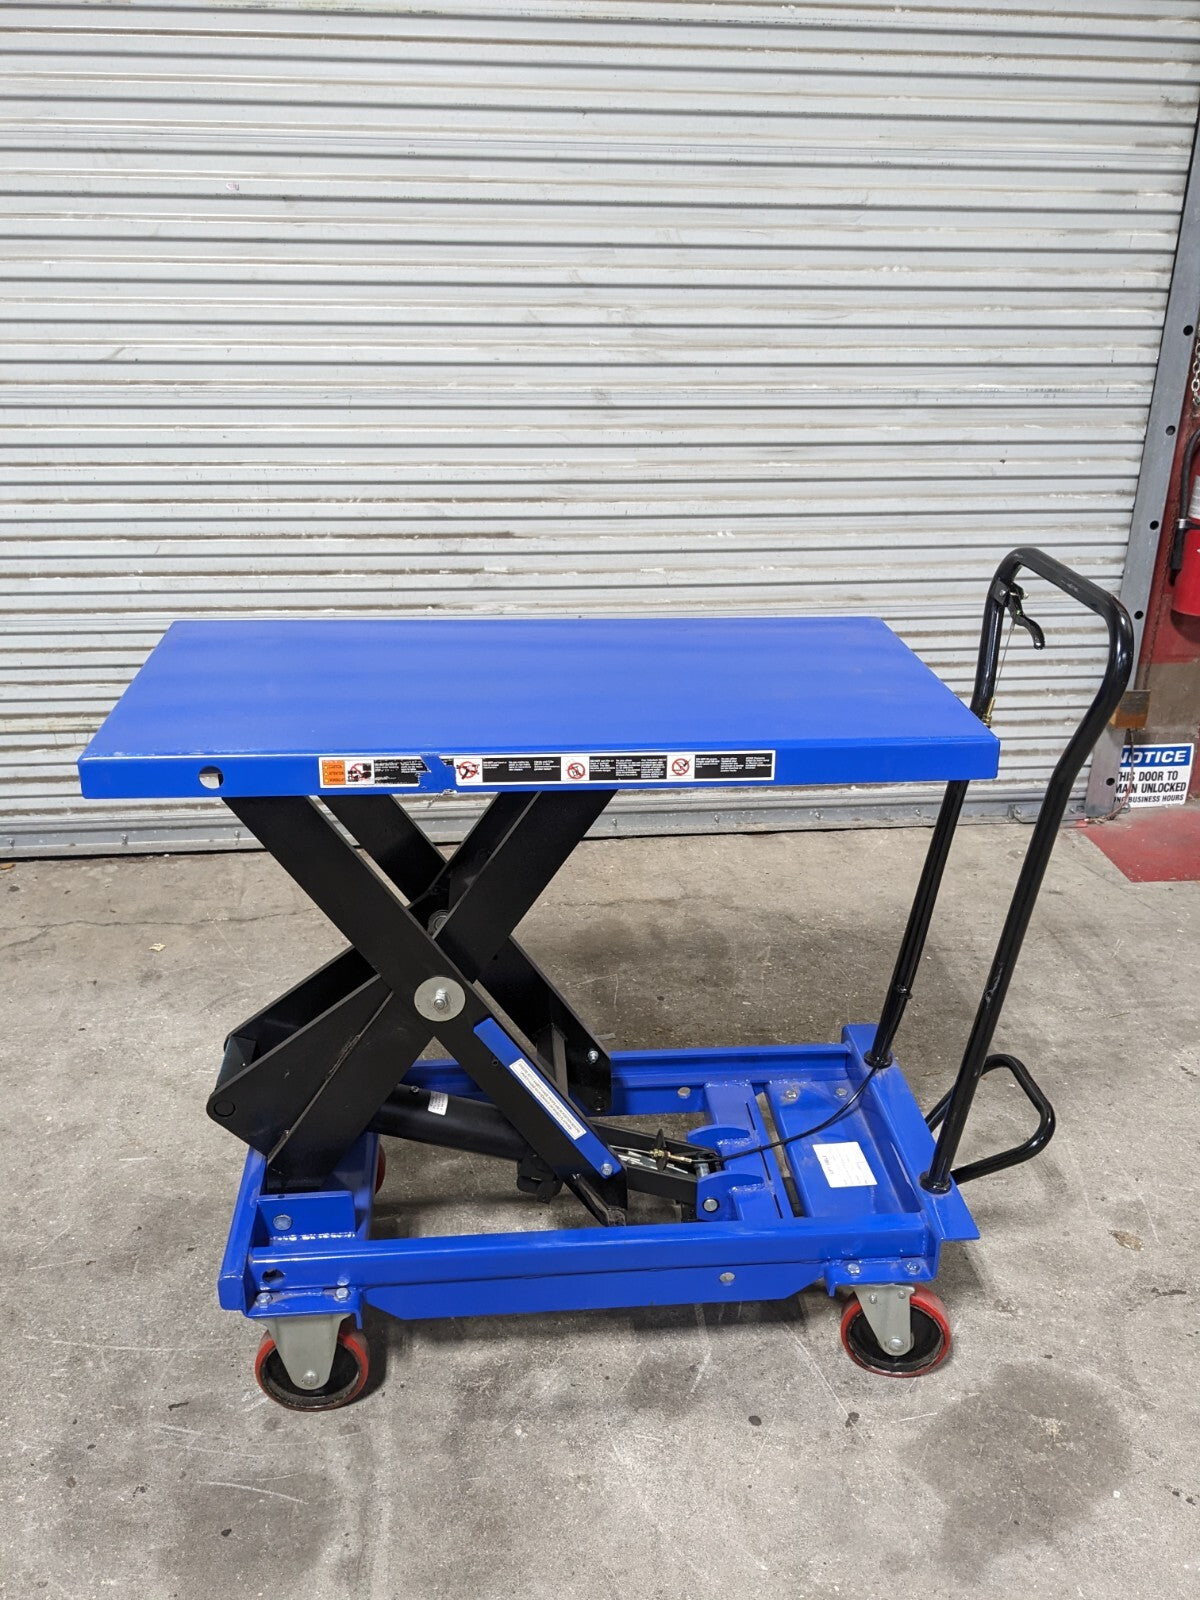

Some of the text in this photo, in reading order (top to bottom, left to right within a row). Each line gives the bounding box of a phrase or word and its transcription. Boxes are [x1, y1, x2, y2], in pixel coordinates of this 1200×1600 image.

[1138, 771, 1164, 782] DOOR
[1167, 770, 1178, 781] TO
[1141, 782, 1187, 794] UNLOCKED
[1162, 794, 1184, 802] HOURS
